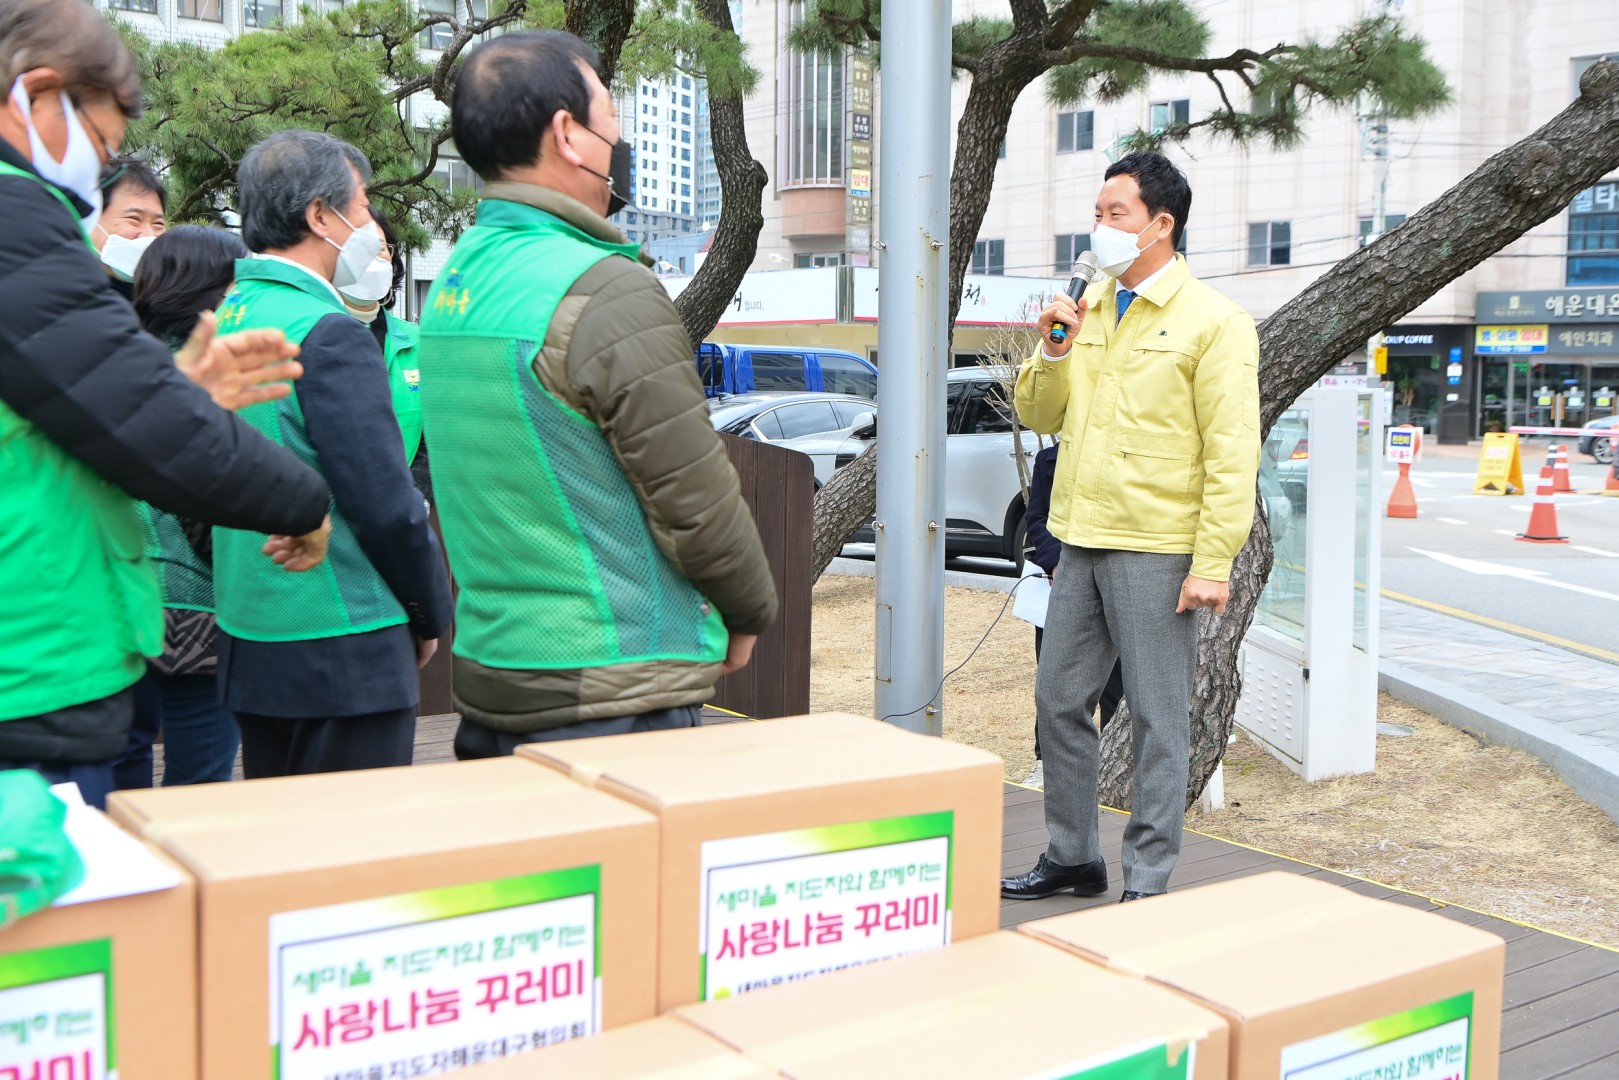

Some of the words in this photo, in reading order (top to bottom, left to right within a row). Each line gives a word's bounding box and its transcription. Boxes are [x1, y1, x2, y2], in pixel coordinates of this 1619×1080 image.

[852, 174, 869, 188] 임대
[1405, 335, 1434, 344] COFFEE
[717, 884, 777, 912] 새마을
[785, 872, 862, 902] 지도자와
[869, 862, 941, 890] 함께하는
[715, 911, 844, 961] 사랑나눔
[854, 893, 939, 937] 꾸러미
[292, 959, 371, 994] 새마을
[382, 942, 484, 977] 지도자와
[493, 924, 586, 960] 함께하는
[293, 988, 460, 1052] 사랑나눔
[476, 959, 585, 1013] 꾸러미
